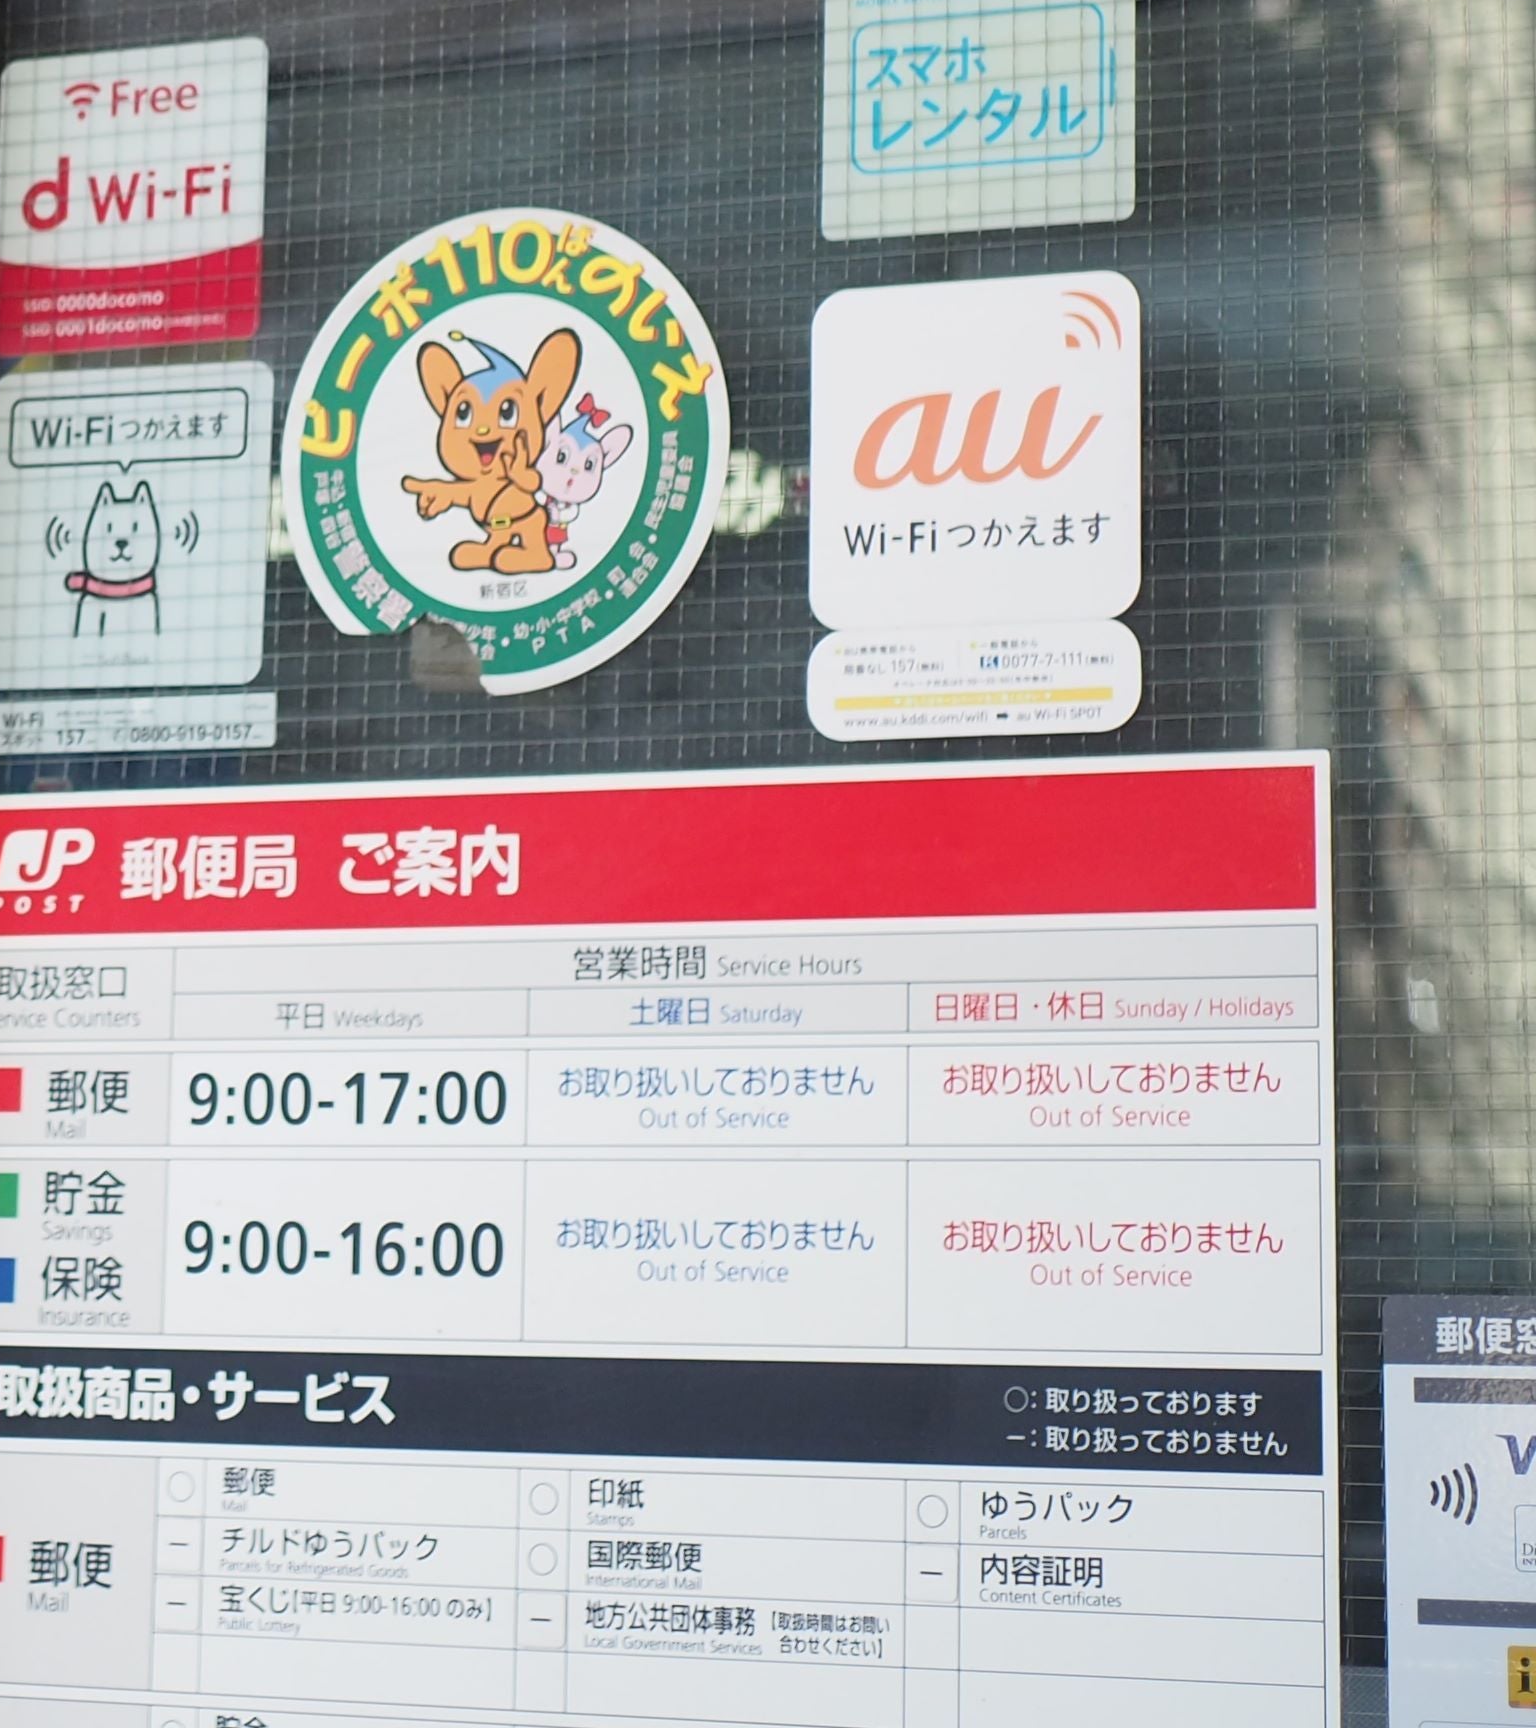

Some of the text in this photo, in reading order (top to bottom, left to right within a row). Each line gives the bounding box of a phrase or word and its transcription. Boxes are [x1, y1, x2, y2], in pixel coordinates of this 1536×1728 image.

[866, 36, 988, 90] スマホ
[111, 80, 200, 117] Free
[872, 84, 1088, 151] レンタル
[88, 164, 232, 224] Wi-Fi
[853, 385, 1105, 490] au
[129, 723, 254, 744] 0800-919-0157
[118, 824, 521, 901] 郵便局 ご案内
[573, 945, 863, 982] 営業時間 Service Hours
[53, 1007, 141, 1030] Counters
[275, 1002, 424, 1032] 平日 Weekdays
[629, 997, 803, 1028] 土曜日 Saturday
[1114, 998, 1188, 1022] Sunday
[1209, 996, 1295, 1022] Holidays
[45, 1068, 130, 1116] 郵便
[557, 1065, 874, 1098] お取り扱いしておりません
[942, 1062, 1282, 1097] お取り扱いしておりません
[188, 1070, 509, 1126] 9:00-17:00
[44, 1119, 87, 1141] Mail
[638, 1106, 791, 1130] Out of Service
[1029, 1104, 1192, 1128] Out of Service
[42, 1170, 127, 1218] 貯金
[40, 1220, 114, 1245] Savings
[183, 1218, 506, 1278] 9:00-16:00
[555, 1217, 875, 1254] お取り扱いしておりません
[942, 1219, 1285, 1257] お取り扱いしておりません
[39, 1254, 124, 1303] 保険
[636, 1258, 790, 1285] Out of Service
[1030, 1263, 1194, 1290] Out of Service
[38, 1306, 131, 1328] Insurance
[222, 1466, 277, 1497] 郵便
[588, 1477, 645, 1509] 印紙
[586, 1511, 635, 1528] Stamps
[981, 1490, 1134, 1524] ゆうパック
[979, 1524, 1028, 1540] Parcels
[27, 1539, 114, 1589] 郵便
[588, 1539, 703, 1573] 国際郵便
[980, 1553, 1104, 1589] 内容証明
[584, 1573, 703, 1591] International Mail
[979, 1588, 1123, 1608] Content Certificates
[27, 1591, 70, 1614] Mail
[585, 1600, 757, 1637] 地方公共団体事務
[583, 1633, 763, 1657] Local Government Services
